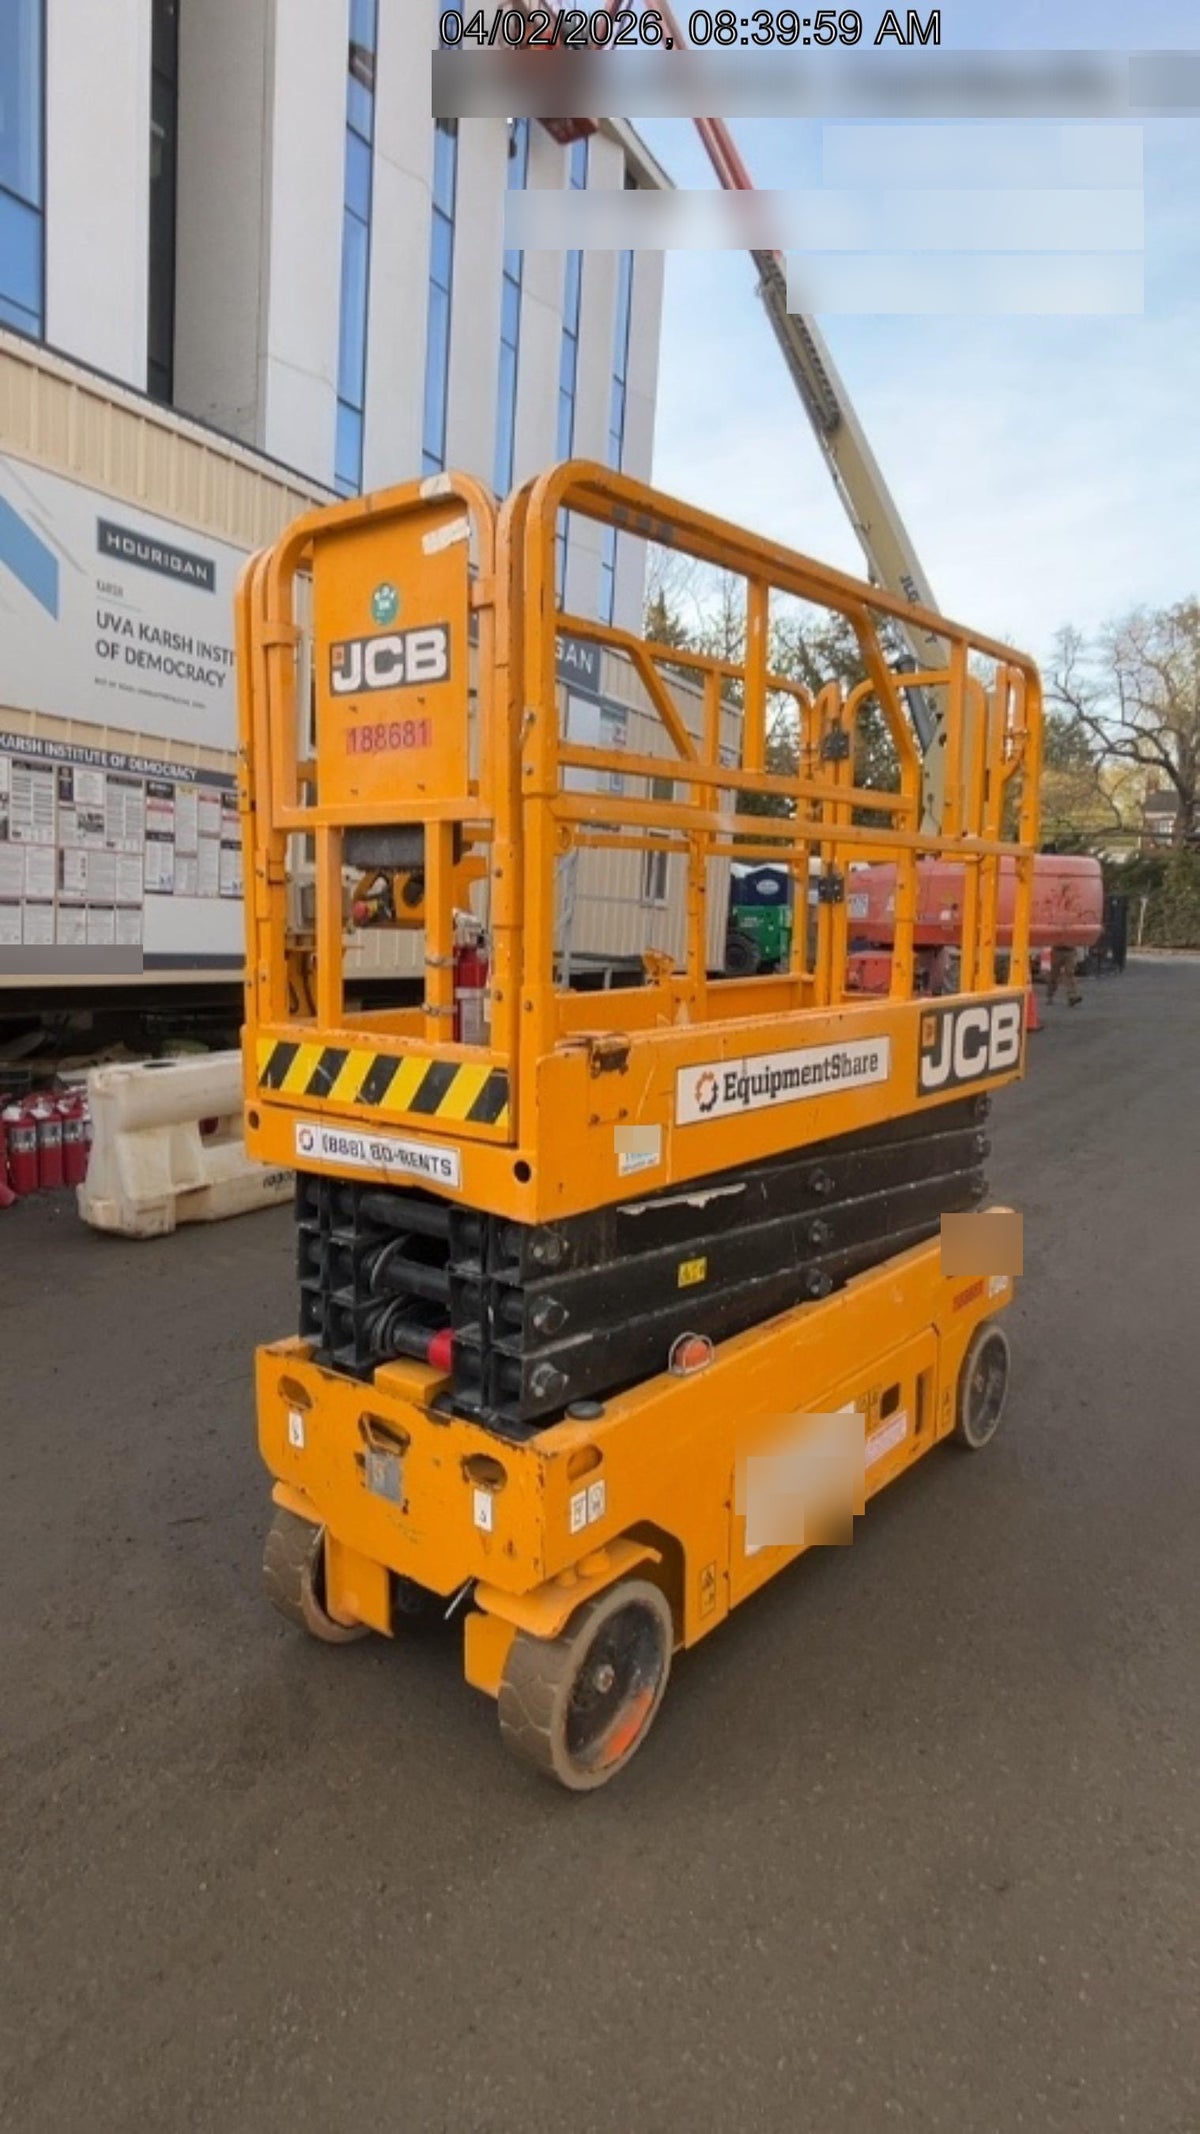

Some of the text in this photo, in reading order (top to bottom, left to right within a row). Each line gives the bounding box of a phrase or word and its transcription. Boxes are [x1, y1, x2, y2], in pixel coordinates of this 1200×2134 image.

[106, 531, 208, 581] HOURIGAN
[96, 609, 133, 638] UVA
[139, 622, 193, 655] KARSH
[95, 638, 226, 688] OF DEMOCRACY
[332, 627, 447, 692] JCB
[44, 741, 107, 767] INSTITUTE
[348, 719, 430, 753] 188681
[922, 1002, 1020, 1087] JCB
[723, 1052, 879, 1104] EquipmentShare
